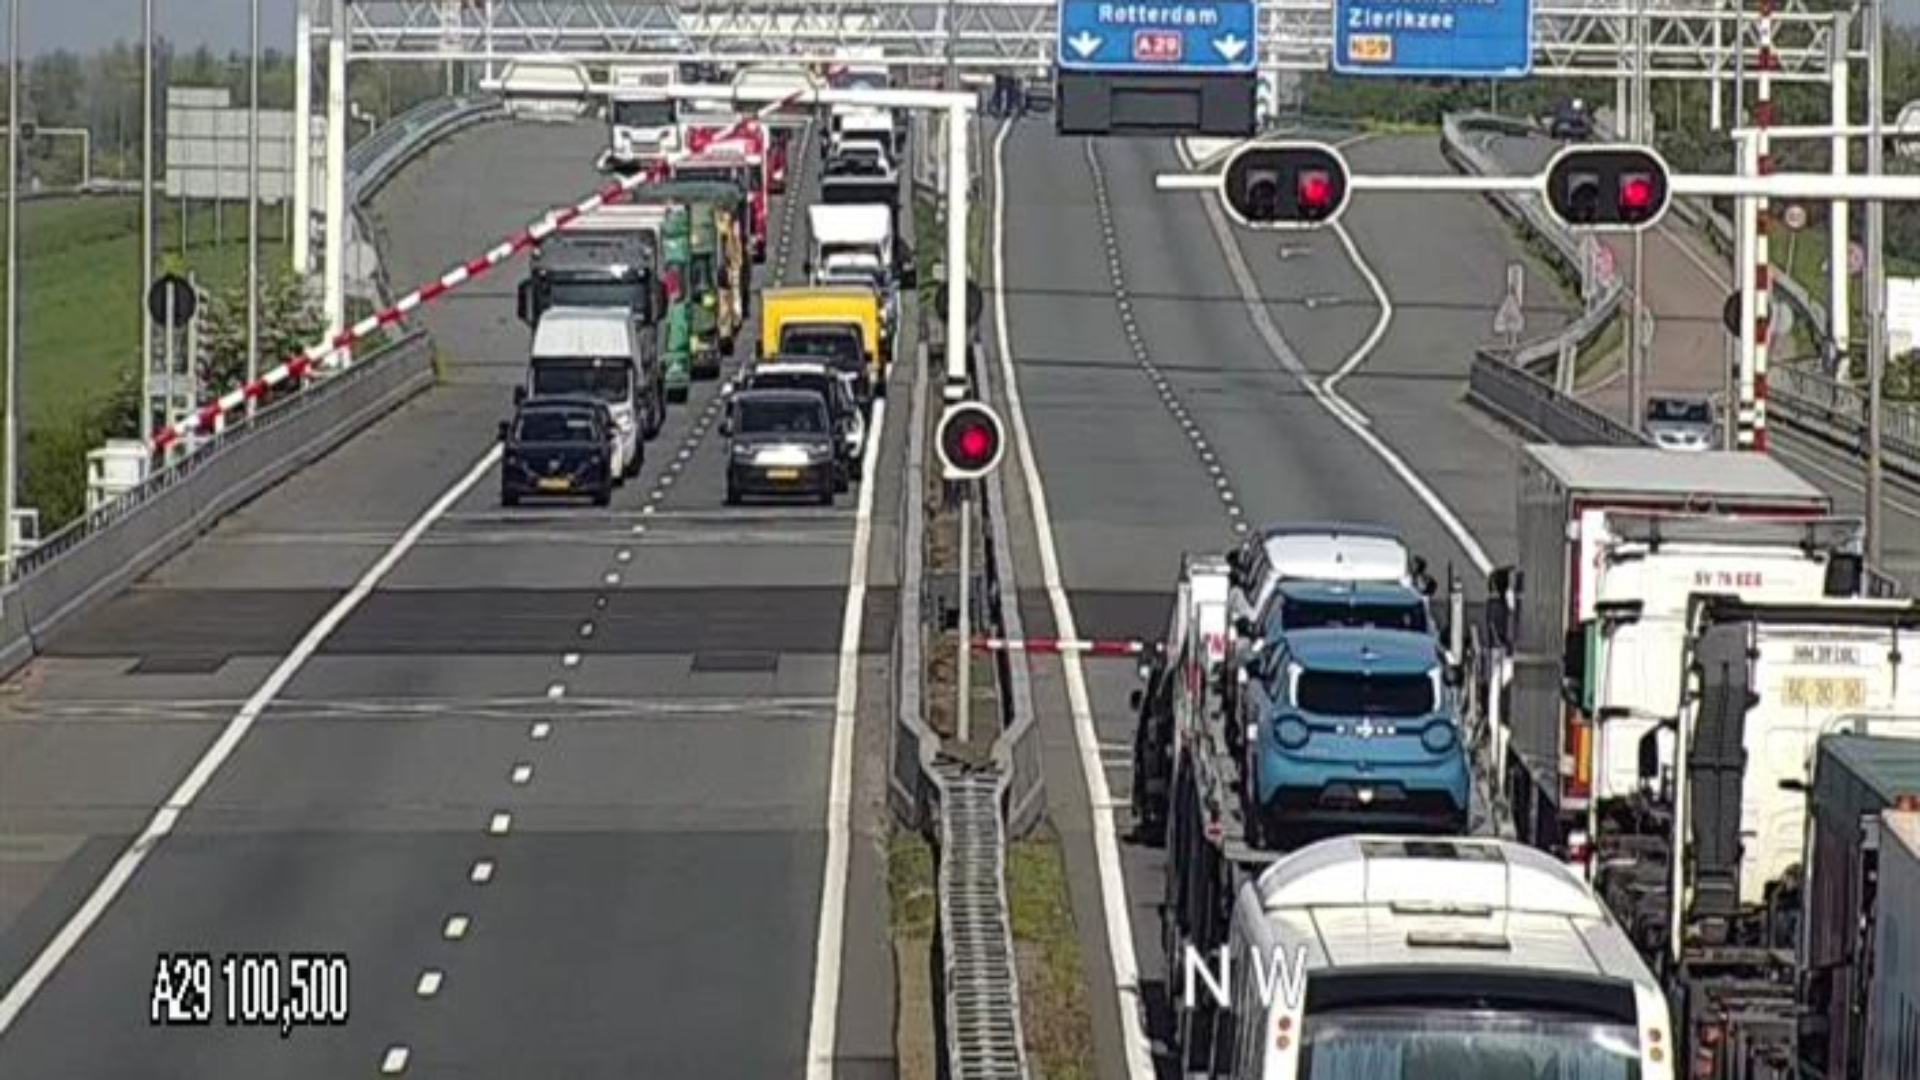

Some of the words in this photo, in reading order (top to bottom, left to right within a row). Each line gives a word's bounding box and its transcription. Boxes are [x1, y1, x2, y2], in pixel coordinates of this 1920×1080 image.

[1098, 4, 1218, 24] Rotterdam
[1348, 8, 1455, 29] Zierikzee
[1138, 36, 1177, 53] A29
